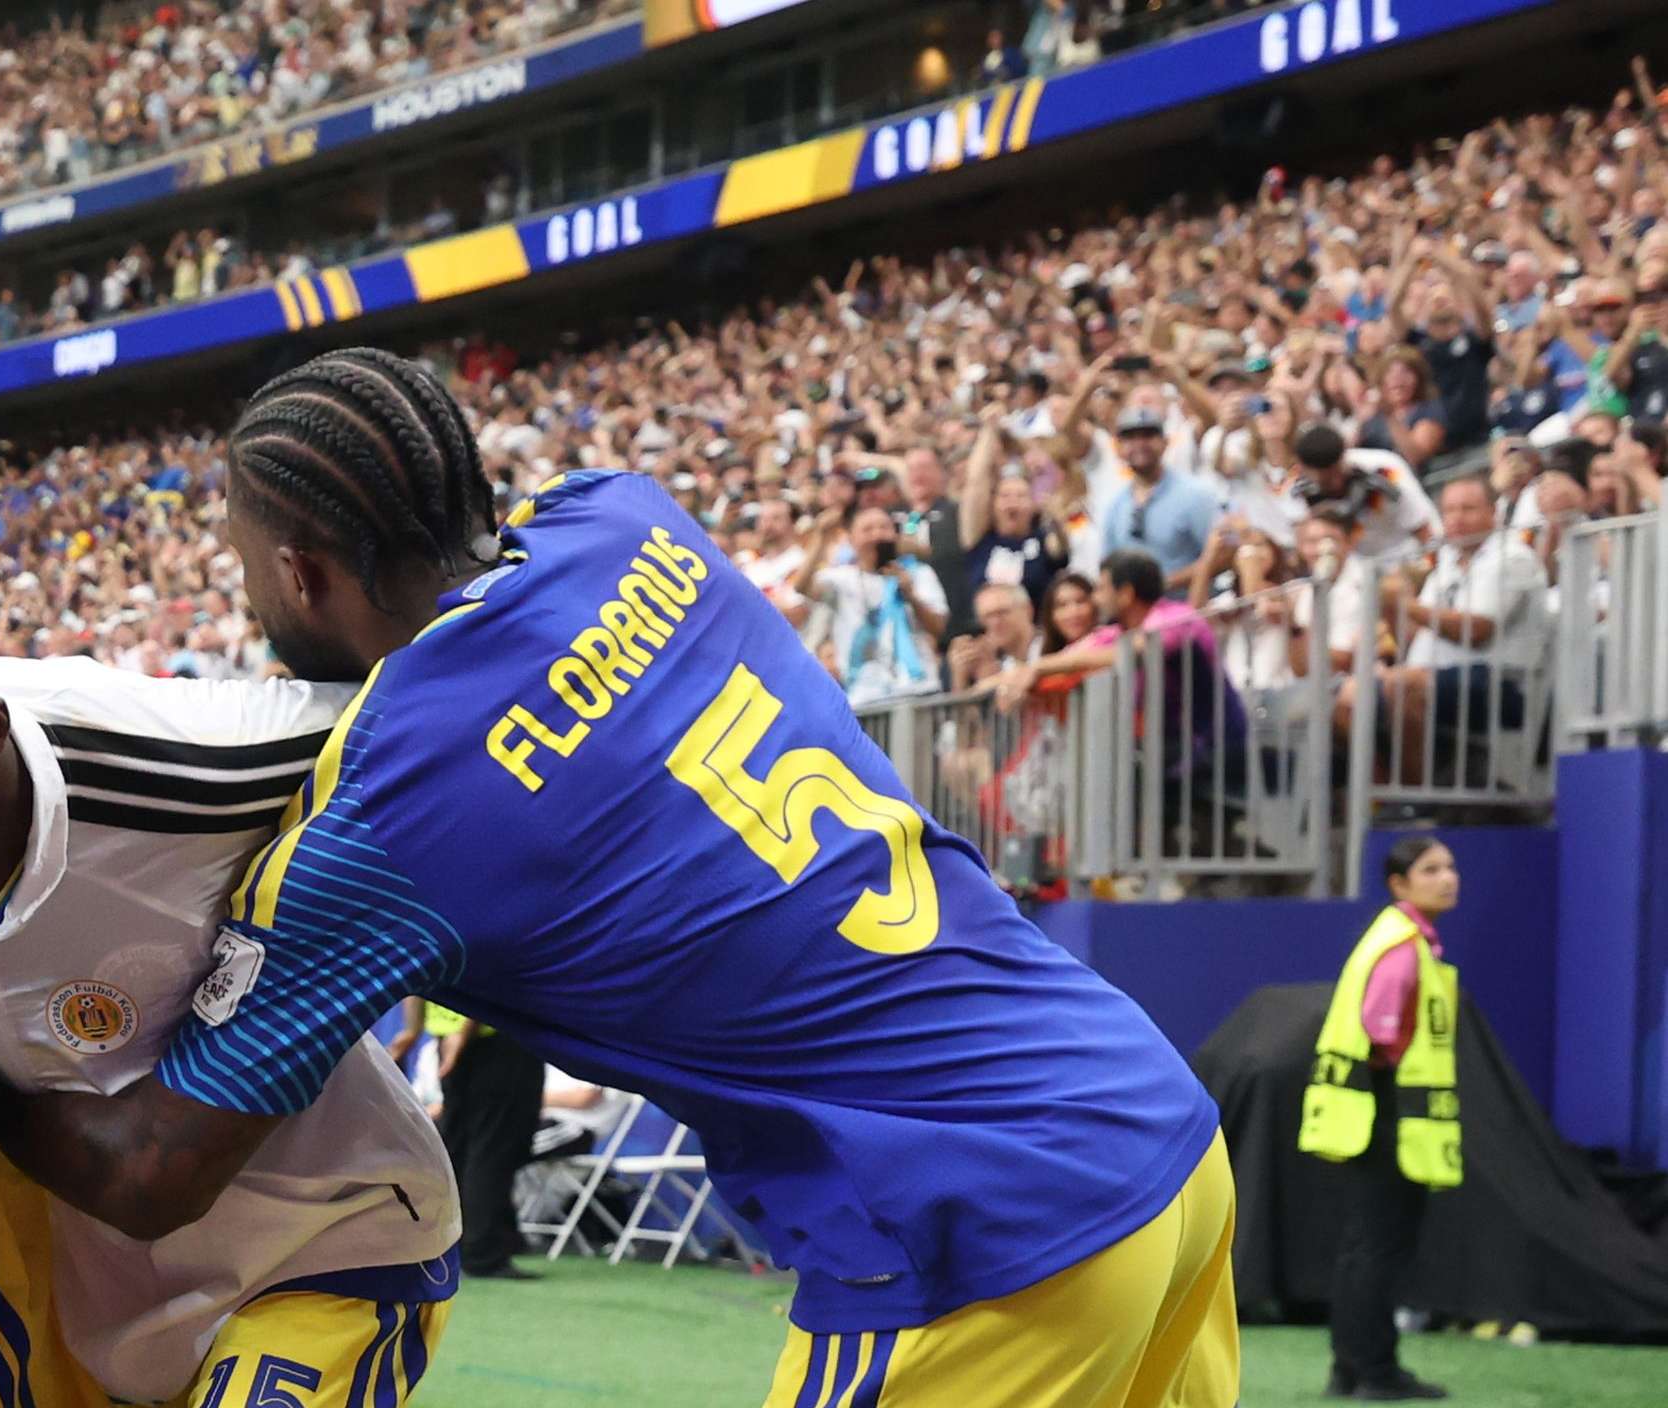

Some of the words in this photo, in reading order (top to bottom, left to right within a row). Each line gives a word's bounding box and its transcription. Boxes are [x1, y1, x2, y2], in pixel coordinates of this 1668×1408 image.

[1260, 0, 1399, 73] GOAL
[372, 58, 526, 131] HOUSTON
[873, 102, 985, 180] GOAL
[546, 195, 642, 264] GOAL
[486, 526, 709, 793] FLORANUS
[664, 662, 940, 955] 5
